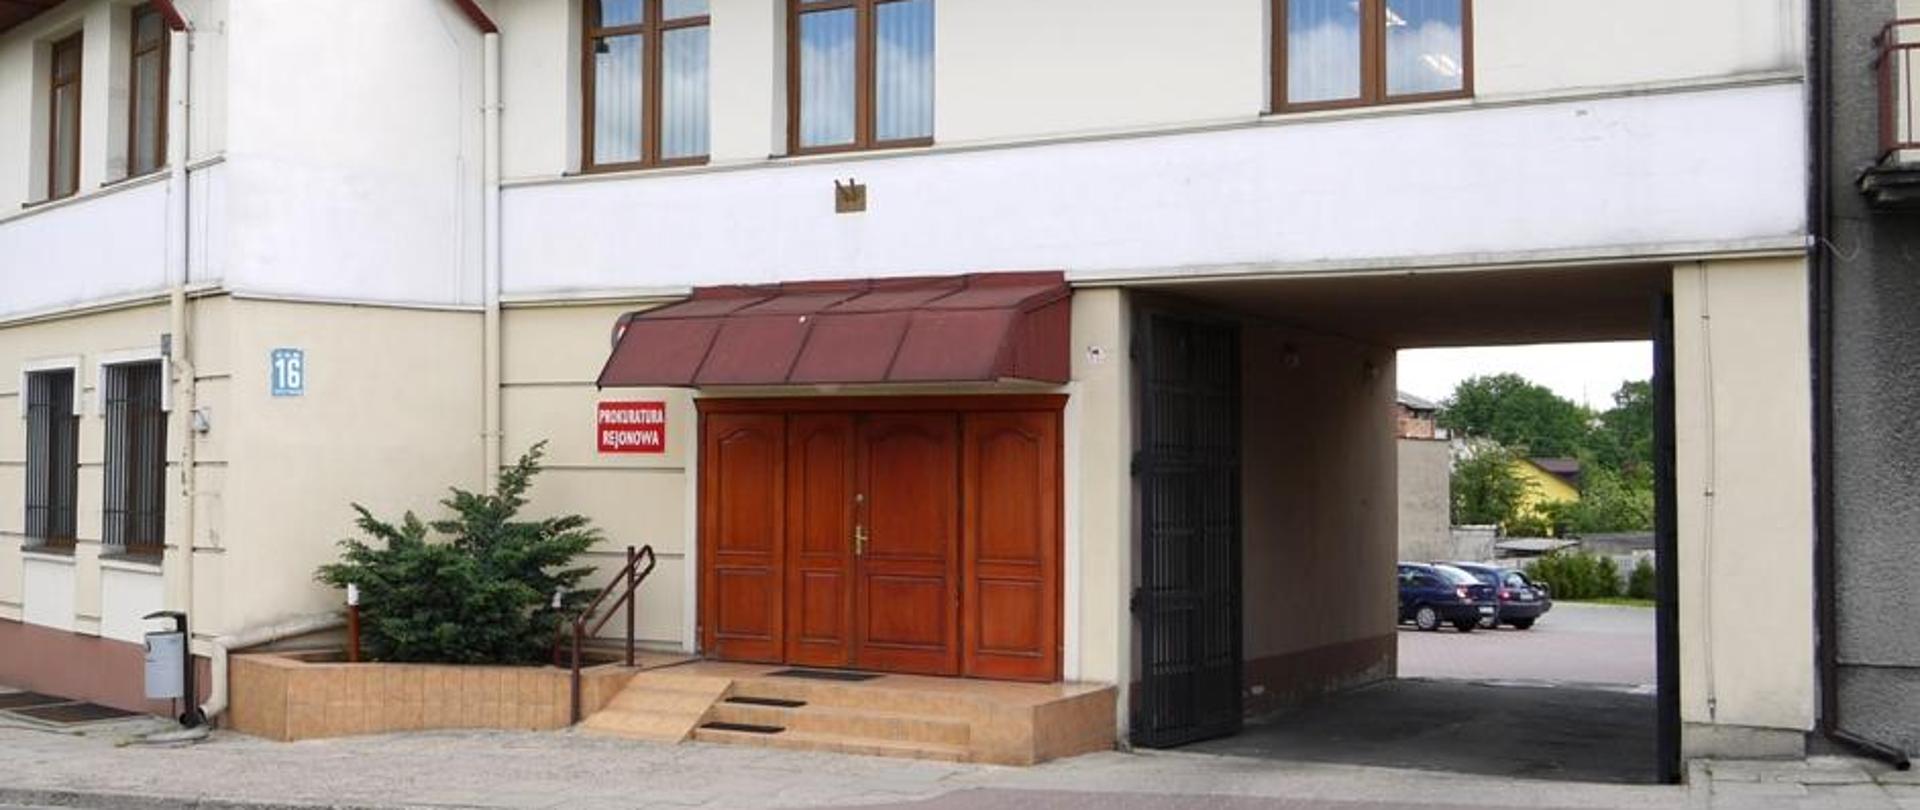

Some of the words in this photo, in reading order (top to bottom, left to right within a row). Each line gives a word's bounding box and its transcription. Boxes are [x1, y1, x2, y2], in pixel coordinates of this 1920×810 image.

[275, 358, 300, 388] 16
[599, 409, 664, 424] PROKURATURA
[602, 430, 660, 449] REJONOWA
